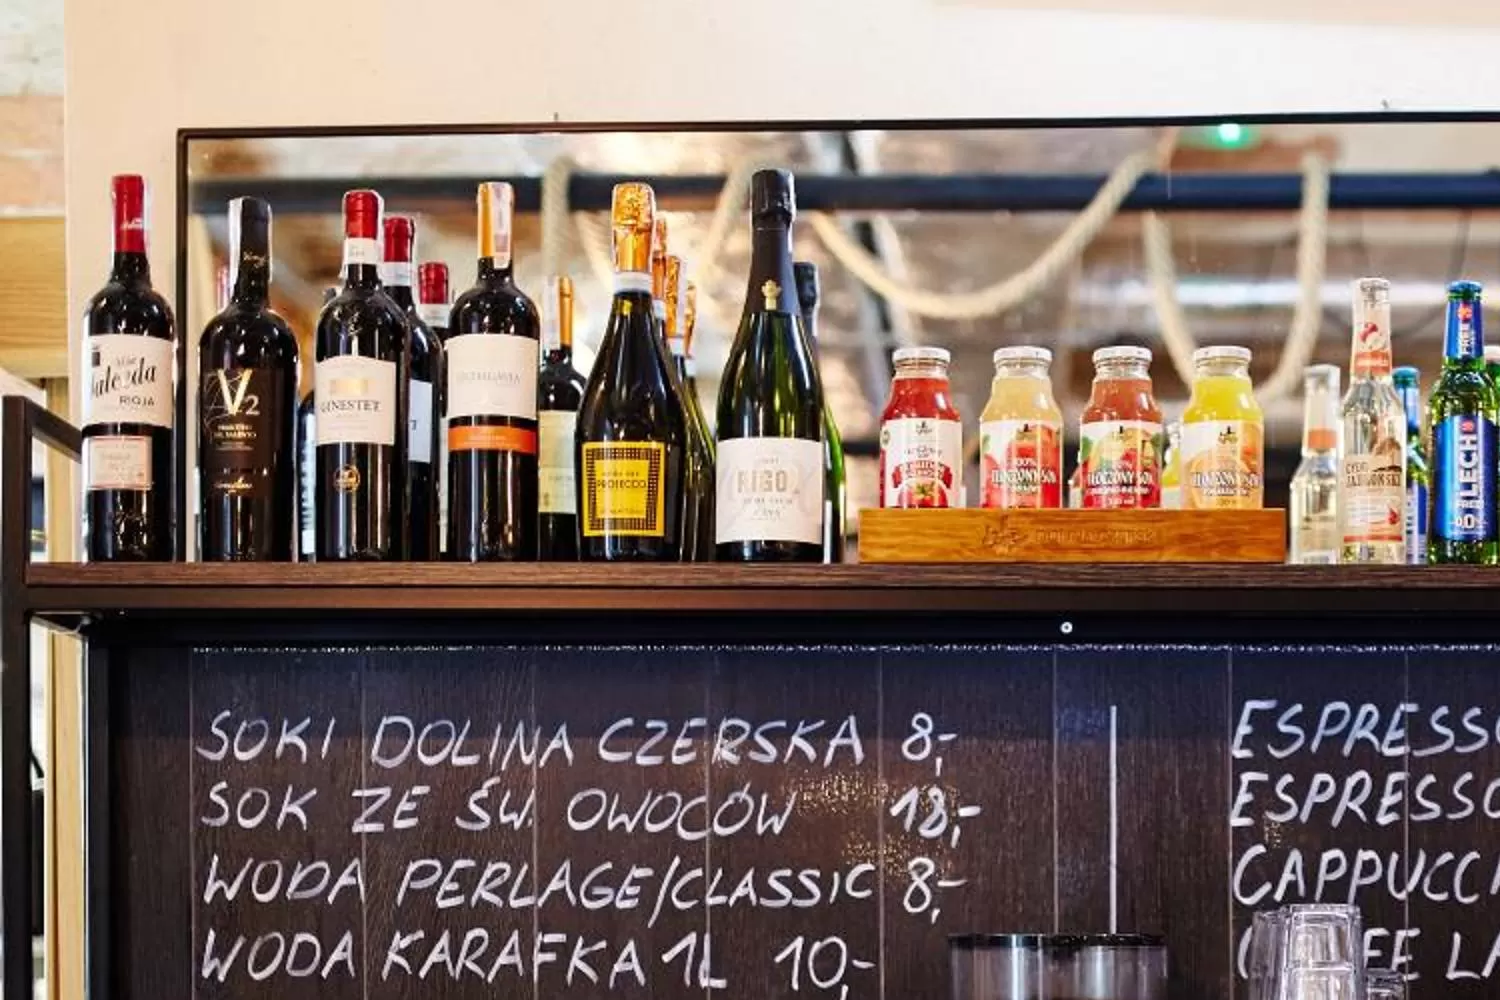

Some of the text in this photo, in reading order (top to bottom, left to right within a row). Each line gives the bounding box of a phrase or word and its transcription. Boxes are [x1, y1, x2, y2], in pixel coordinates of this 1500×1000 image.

[1459, 434, 1479, 498] LECH
[195, 710, 336, 765] SOKI
[370, 714, 574, 771] DOLINA
[598, 714, 866, 767] CZERSKA
[201, 780, 318, 832] SOK
[351, 785, 431, 833] ZE
[566, 780, 799, 841] OWOCÓW
[202, 853, 366, 905] WODA
[200, 927, 356, 983] WODA
[381, 927, 646, 989] KARAFKA
[661, 931, 728, 990] 1L
